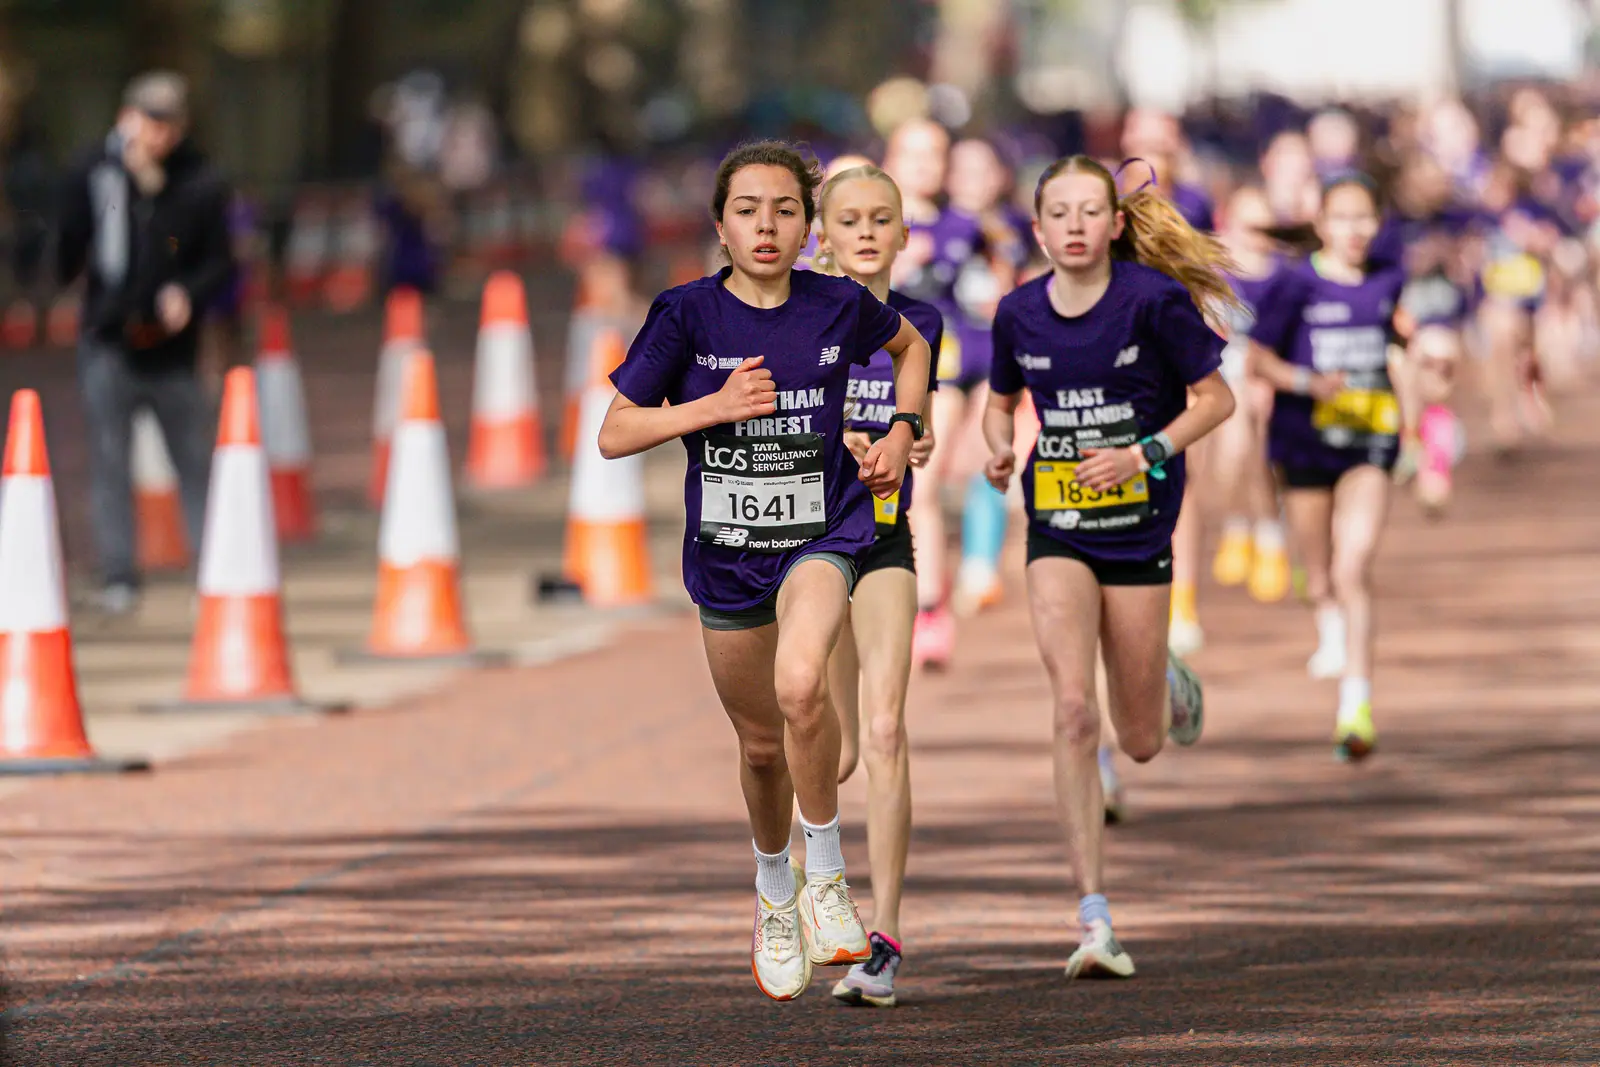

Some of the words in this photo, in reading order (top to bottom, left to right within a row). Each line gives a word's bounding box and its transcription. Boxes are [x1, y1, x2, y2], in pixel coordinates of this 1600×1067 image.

[846, 379, 893, 400] EAST
[1056, 387, 1105, 409] EAST
[1043, 401, 1135, 427] MIDLANDS
[735, 415, 812, 437] FOREST
[704, 439, 748, 471] tcs
[752, 442, 781, 452] TATA
[752, 449, 818, 462] CONSULTANCY
[1037, 430, 1075, 459] tcs
[752, 461, 795, 472] SERVICES
[728, 493, 795, 522] 1641
[748, 540, 771, 549] new
